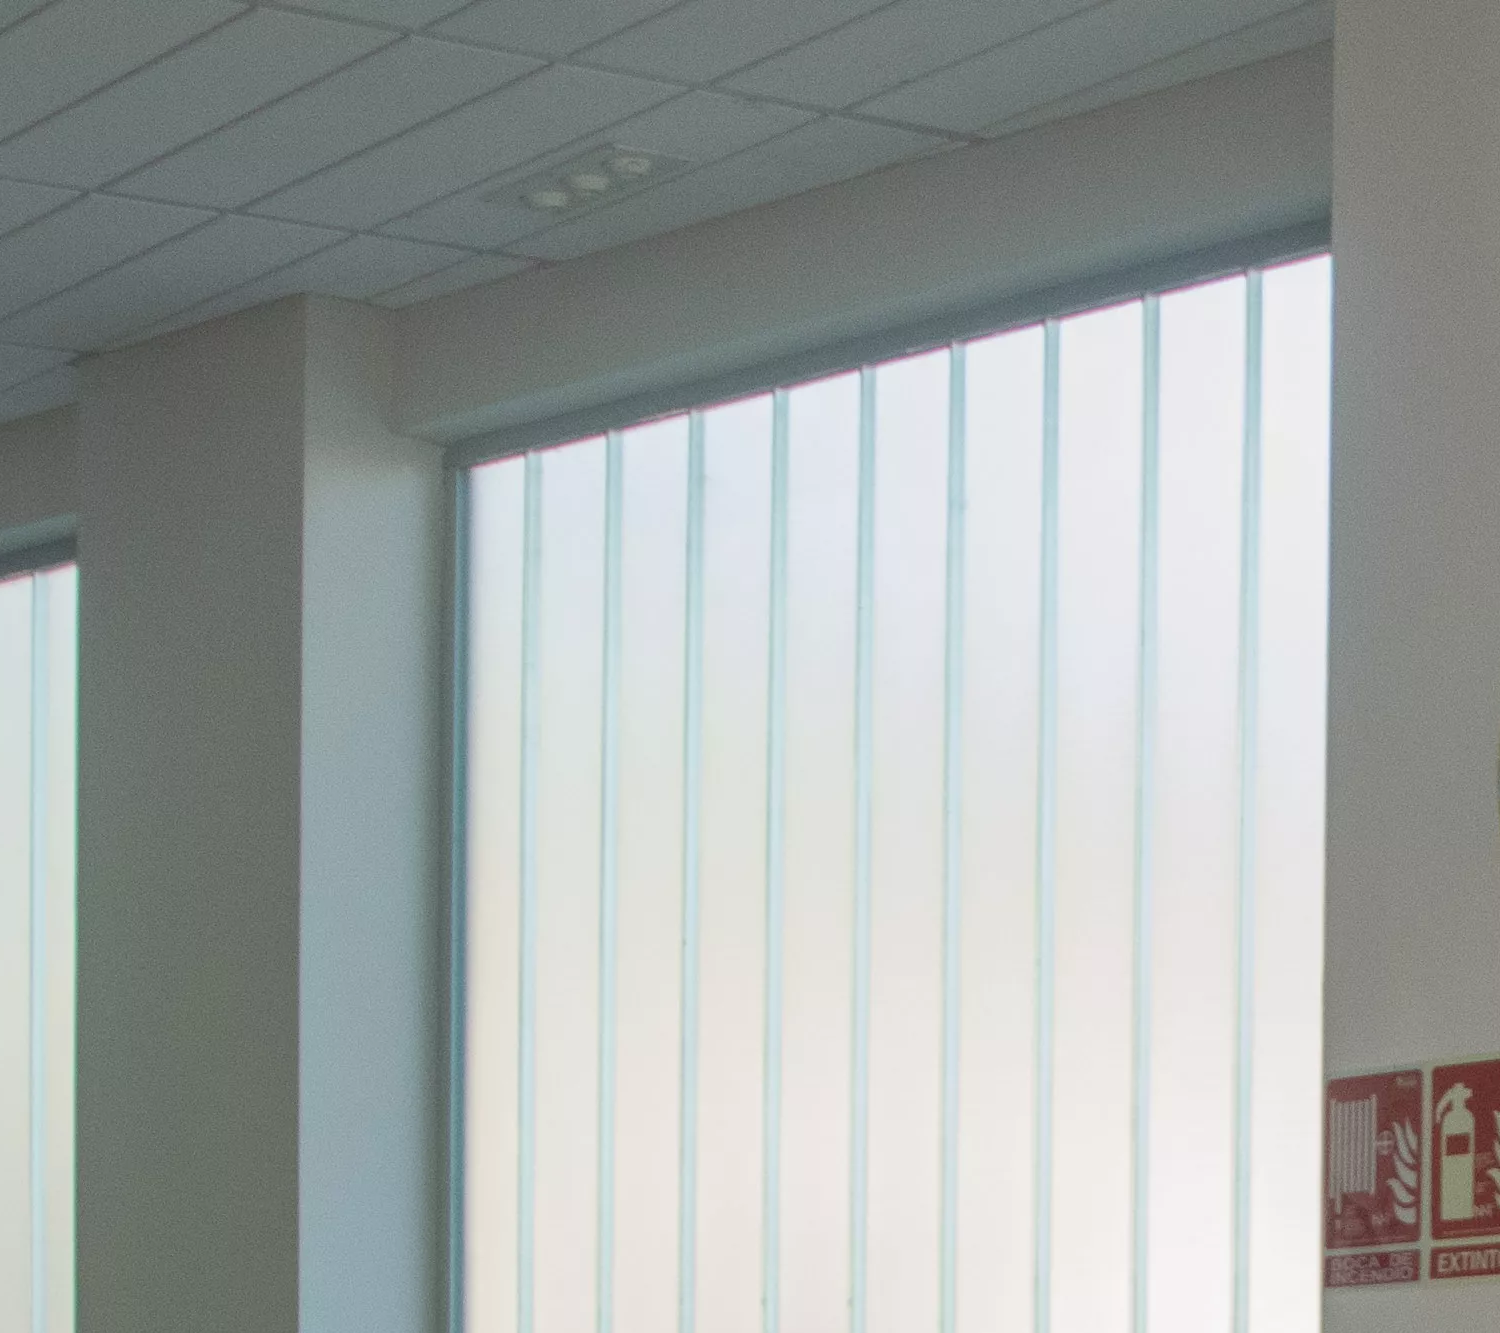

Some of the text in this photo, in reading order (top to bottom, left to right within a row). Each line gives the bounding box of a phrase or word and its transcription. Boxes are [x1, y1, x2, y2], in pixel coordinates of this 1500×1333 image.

[1330, 1251, 1414, 1272] BOCA DE
[1329, 1266, 1413, 1285] INCENDIO
